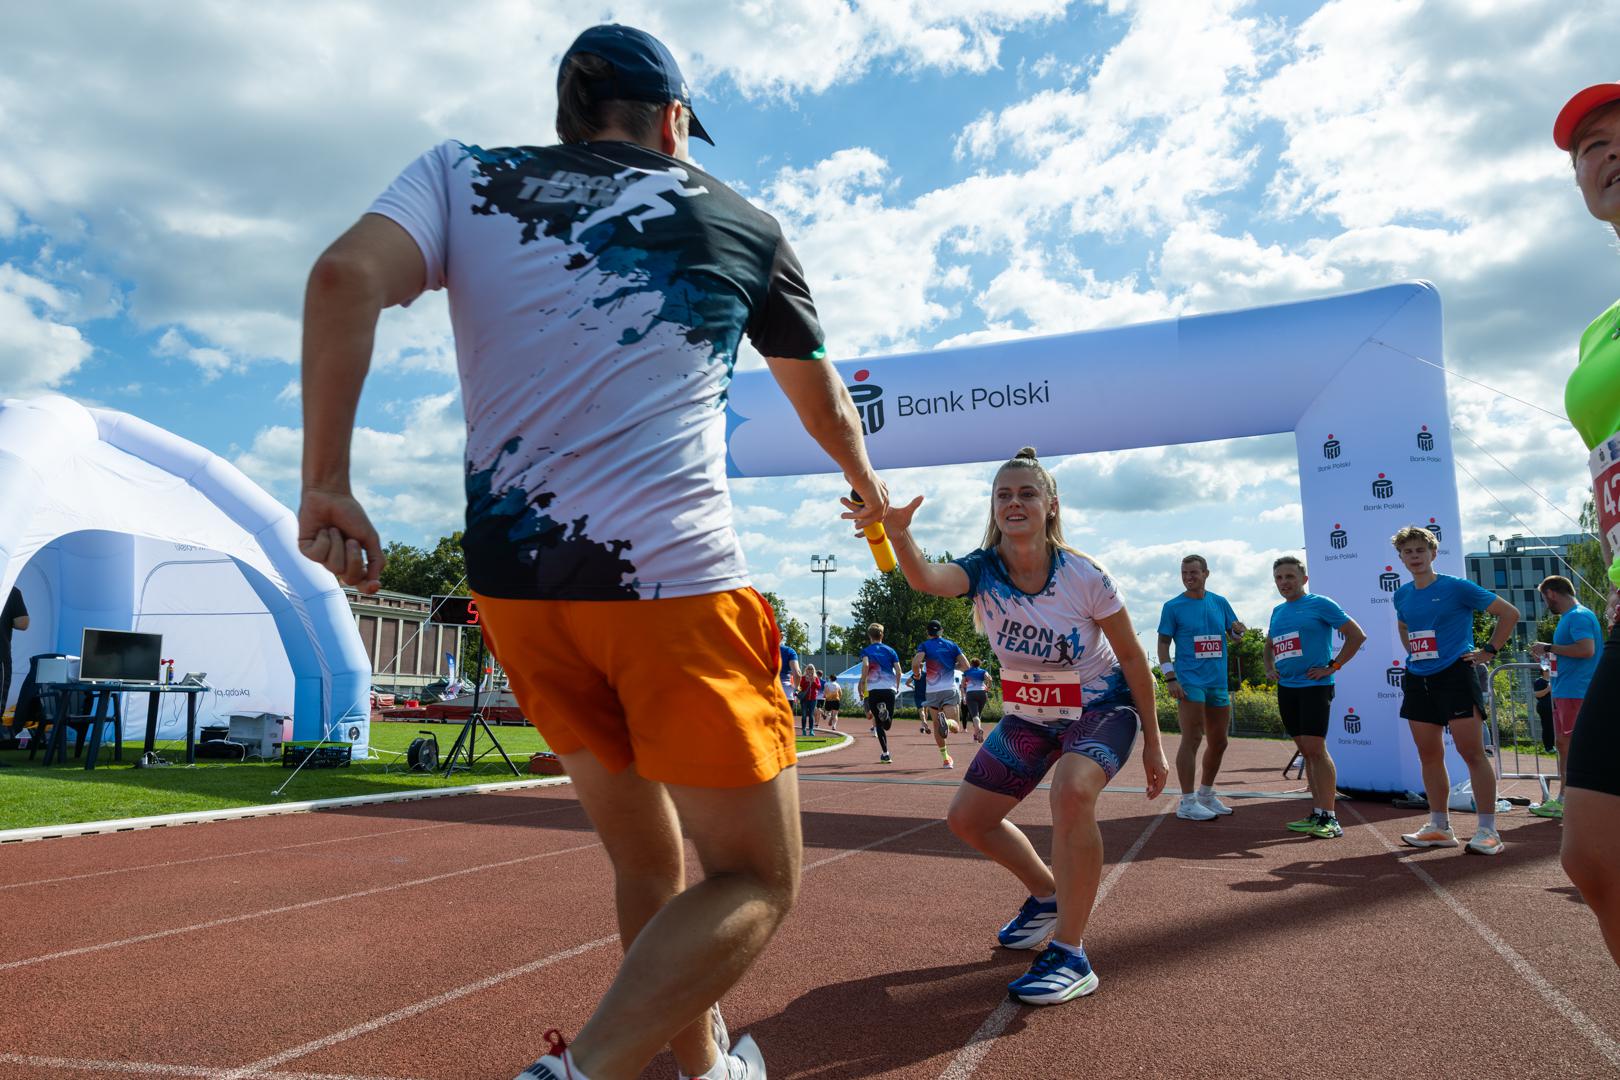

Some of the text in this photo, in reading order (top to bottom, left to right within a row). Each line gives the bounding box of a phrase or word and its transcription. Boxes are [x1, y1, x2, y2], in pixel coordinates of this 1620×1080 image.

[897, 379, 1050, 417] Bank Polski
[1363, 502, 1405, 511] Bank Polski
[1001, 618, 1054, 643] IRON
[996, 631, 1053, 658] TEAM
[1200, 642, 1220, 651] 70/3
[1275, 640, 1294, 654] 70/5
[1015, 686, 1062, 704] 49/1
[1377, 691, 1397, 699] Bank
